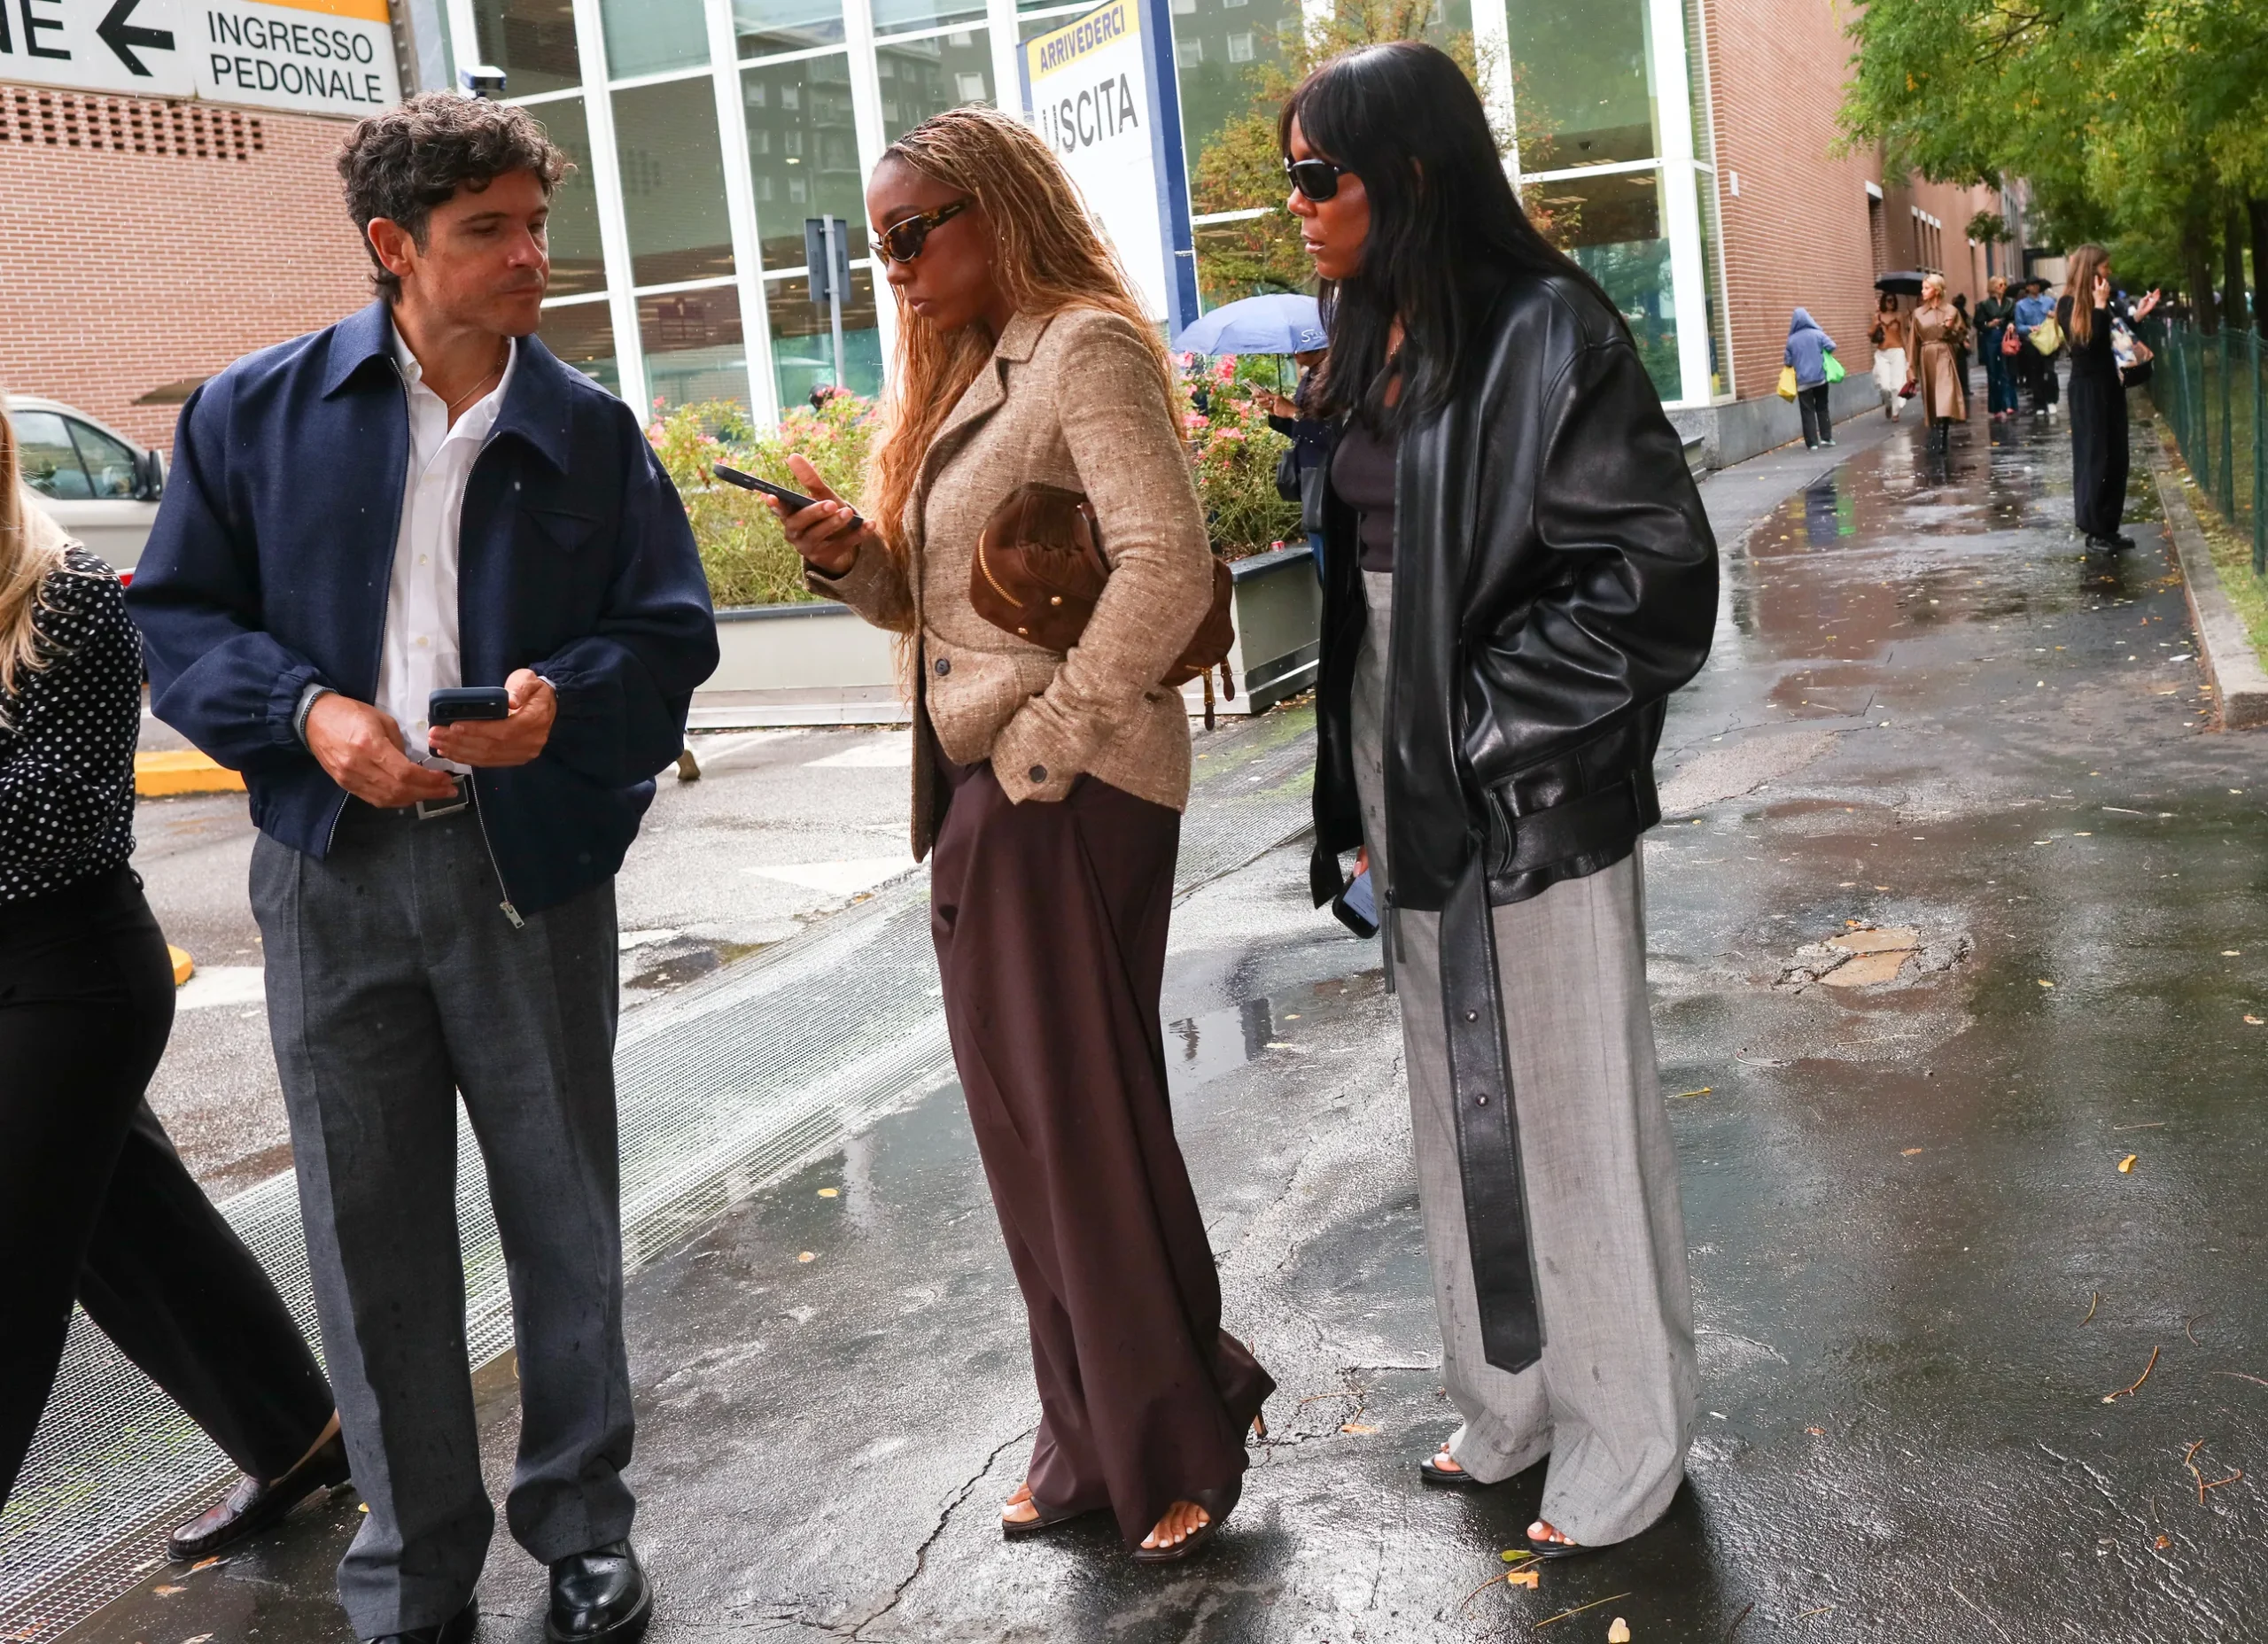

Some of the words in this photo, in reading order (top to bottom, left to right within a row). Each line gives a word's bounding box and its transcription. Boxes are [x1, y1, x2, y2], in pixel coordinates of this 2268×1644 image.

[207, 11, 373, 64] INGRESSO
[1040, 4, 1126, 73] ARRIVEDERCI
[211, 54, 384, 104] PEDONALE
[1043, 73, 1139, 154] USCITA
